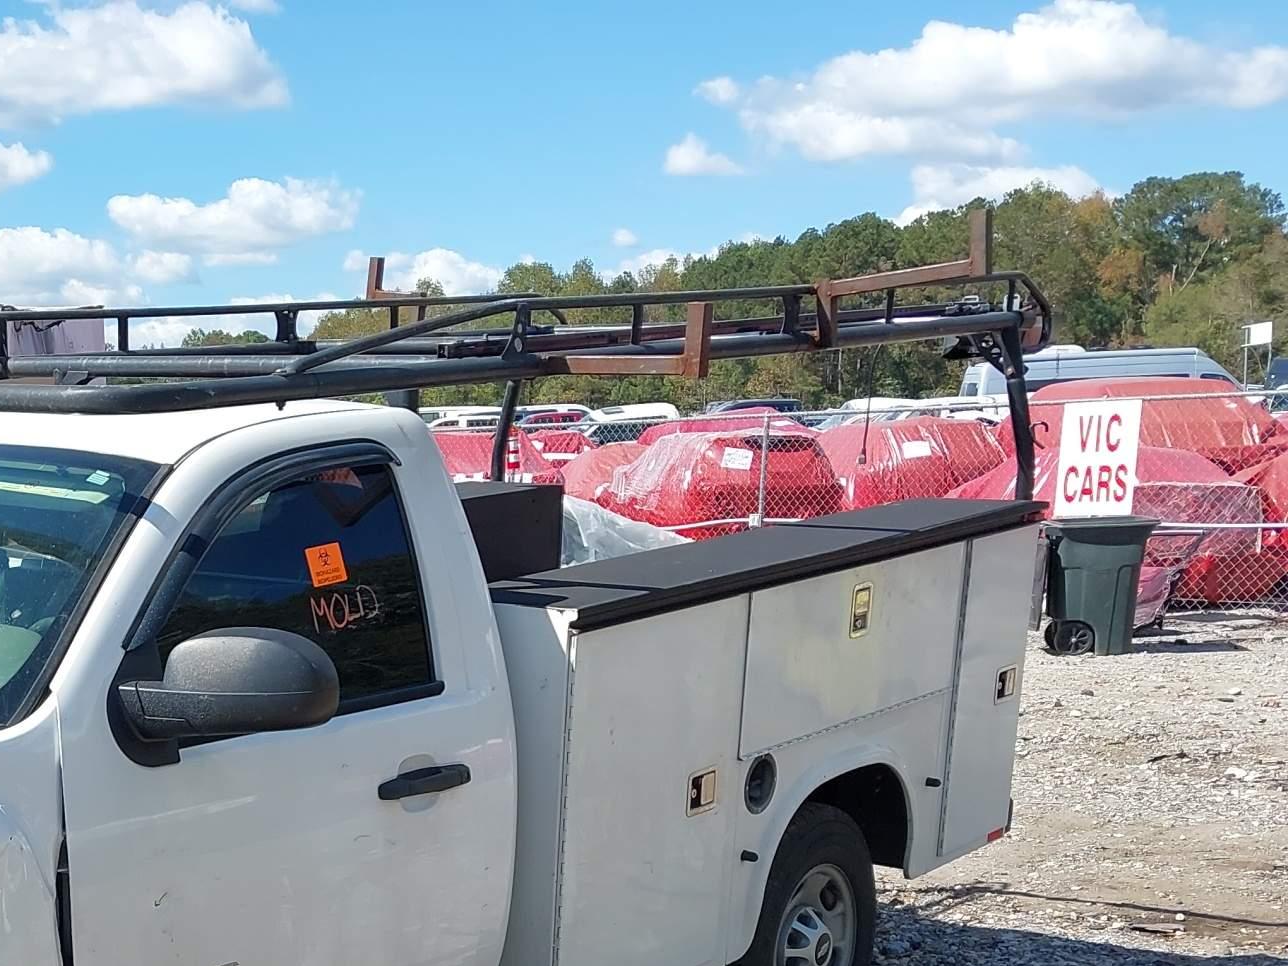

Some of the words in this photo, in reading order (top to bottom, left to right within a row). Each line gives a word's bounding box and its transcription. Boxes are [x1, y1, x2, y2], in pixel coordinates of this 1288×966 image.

[1079, 413, 1122, 453] VIC
[1063, 463, 1128, 503] CARS
[311, 584, 380, 634] MOLD
